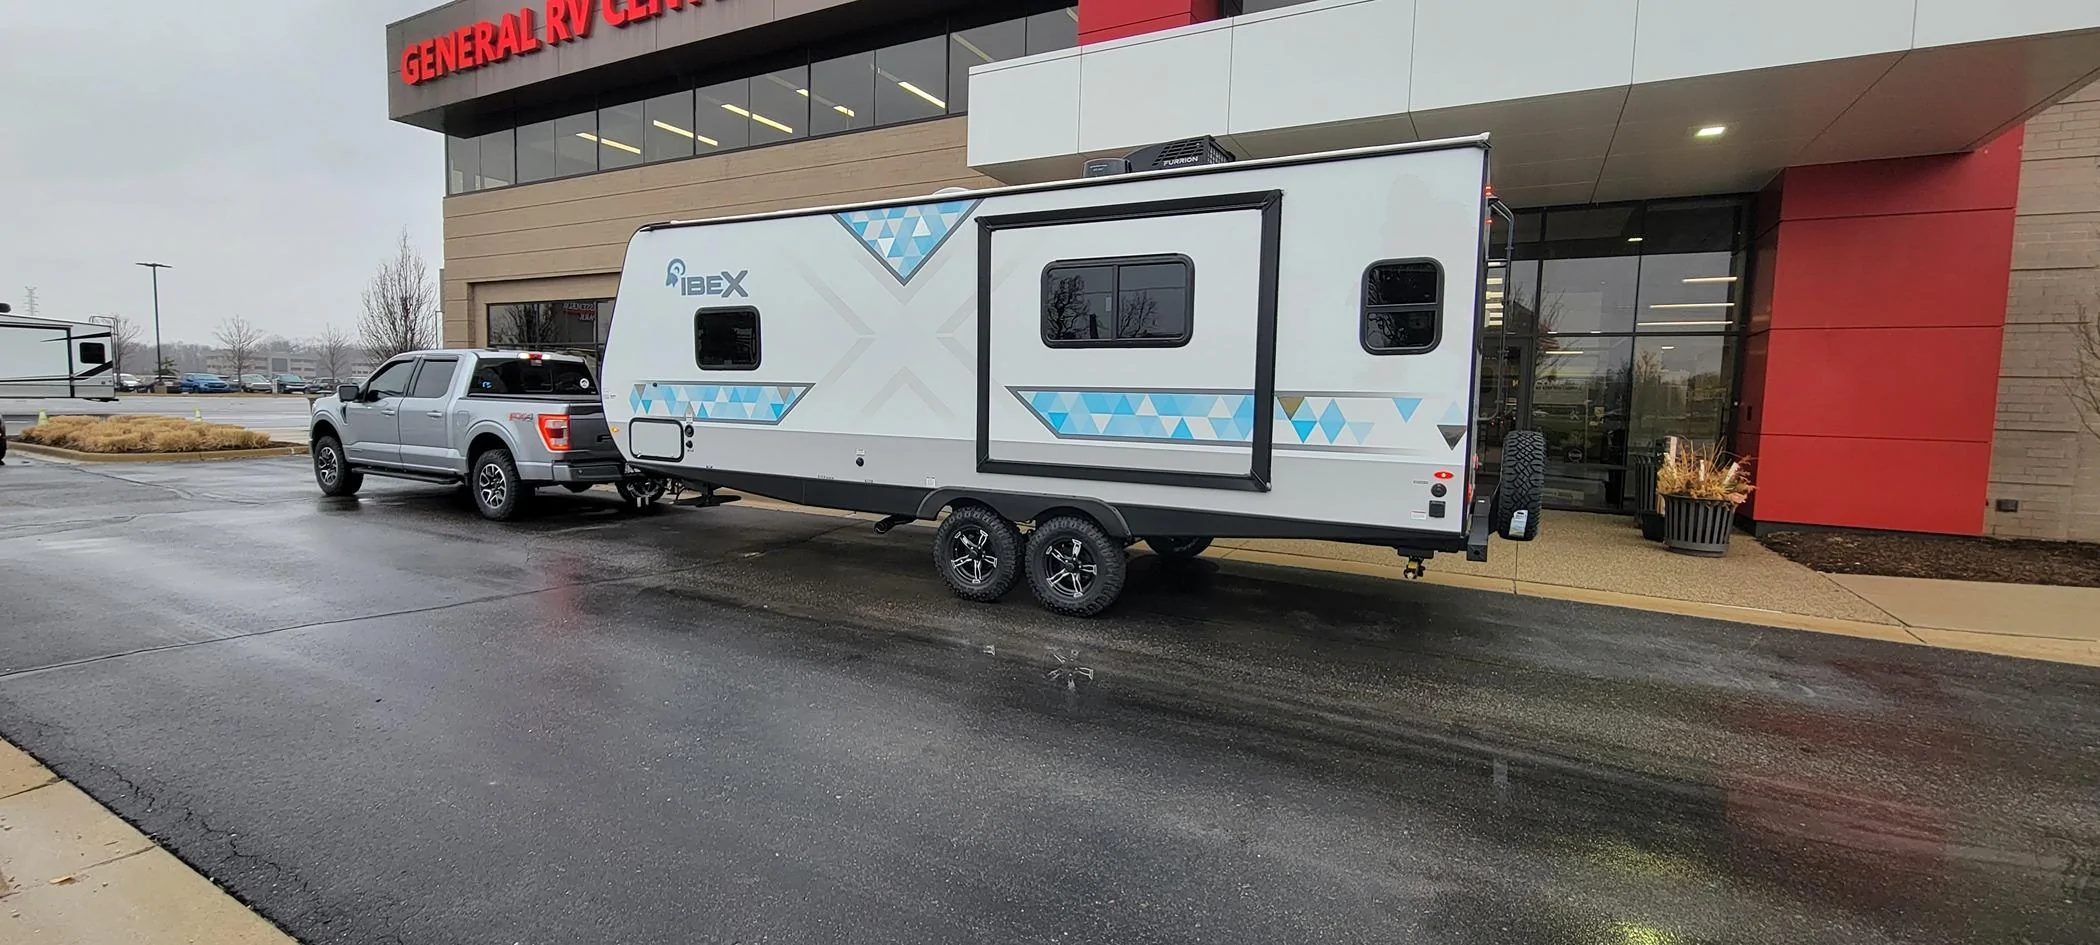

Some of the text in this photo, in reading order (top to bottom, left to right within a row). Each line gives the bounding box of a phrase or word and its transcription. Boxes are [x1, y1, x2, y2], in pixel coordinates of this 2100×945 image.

[400, 8, 541, 86] GENERAL
[545, 0, 592, 46] RV
[1163, 156, 1199, 167] FURRION
[681, 270, 749, 298] IBEX
